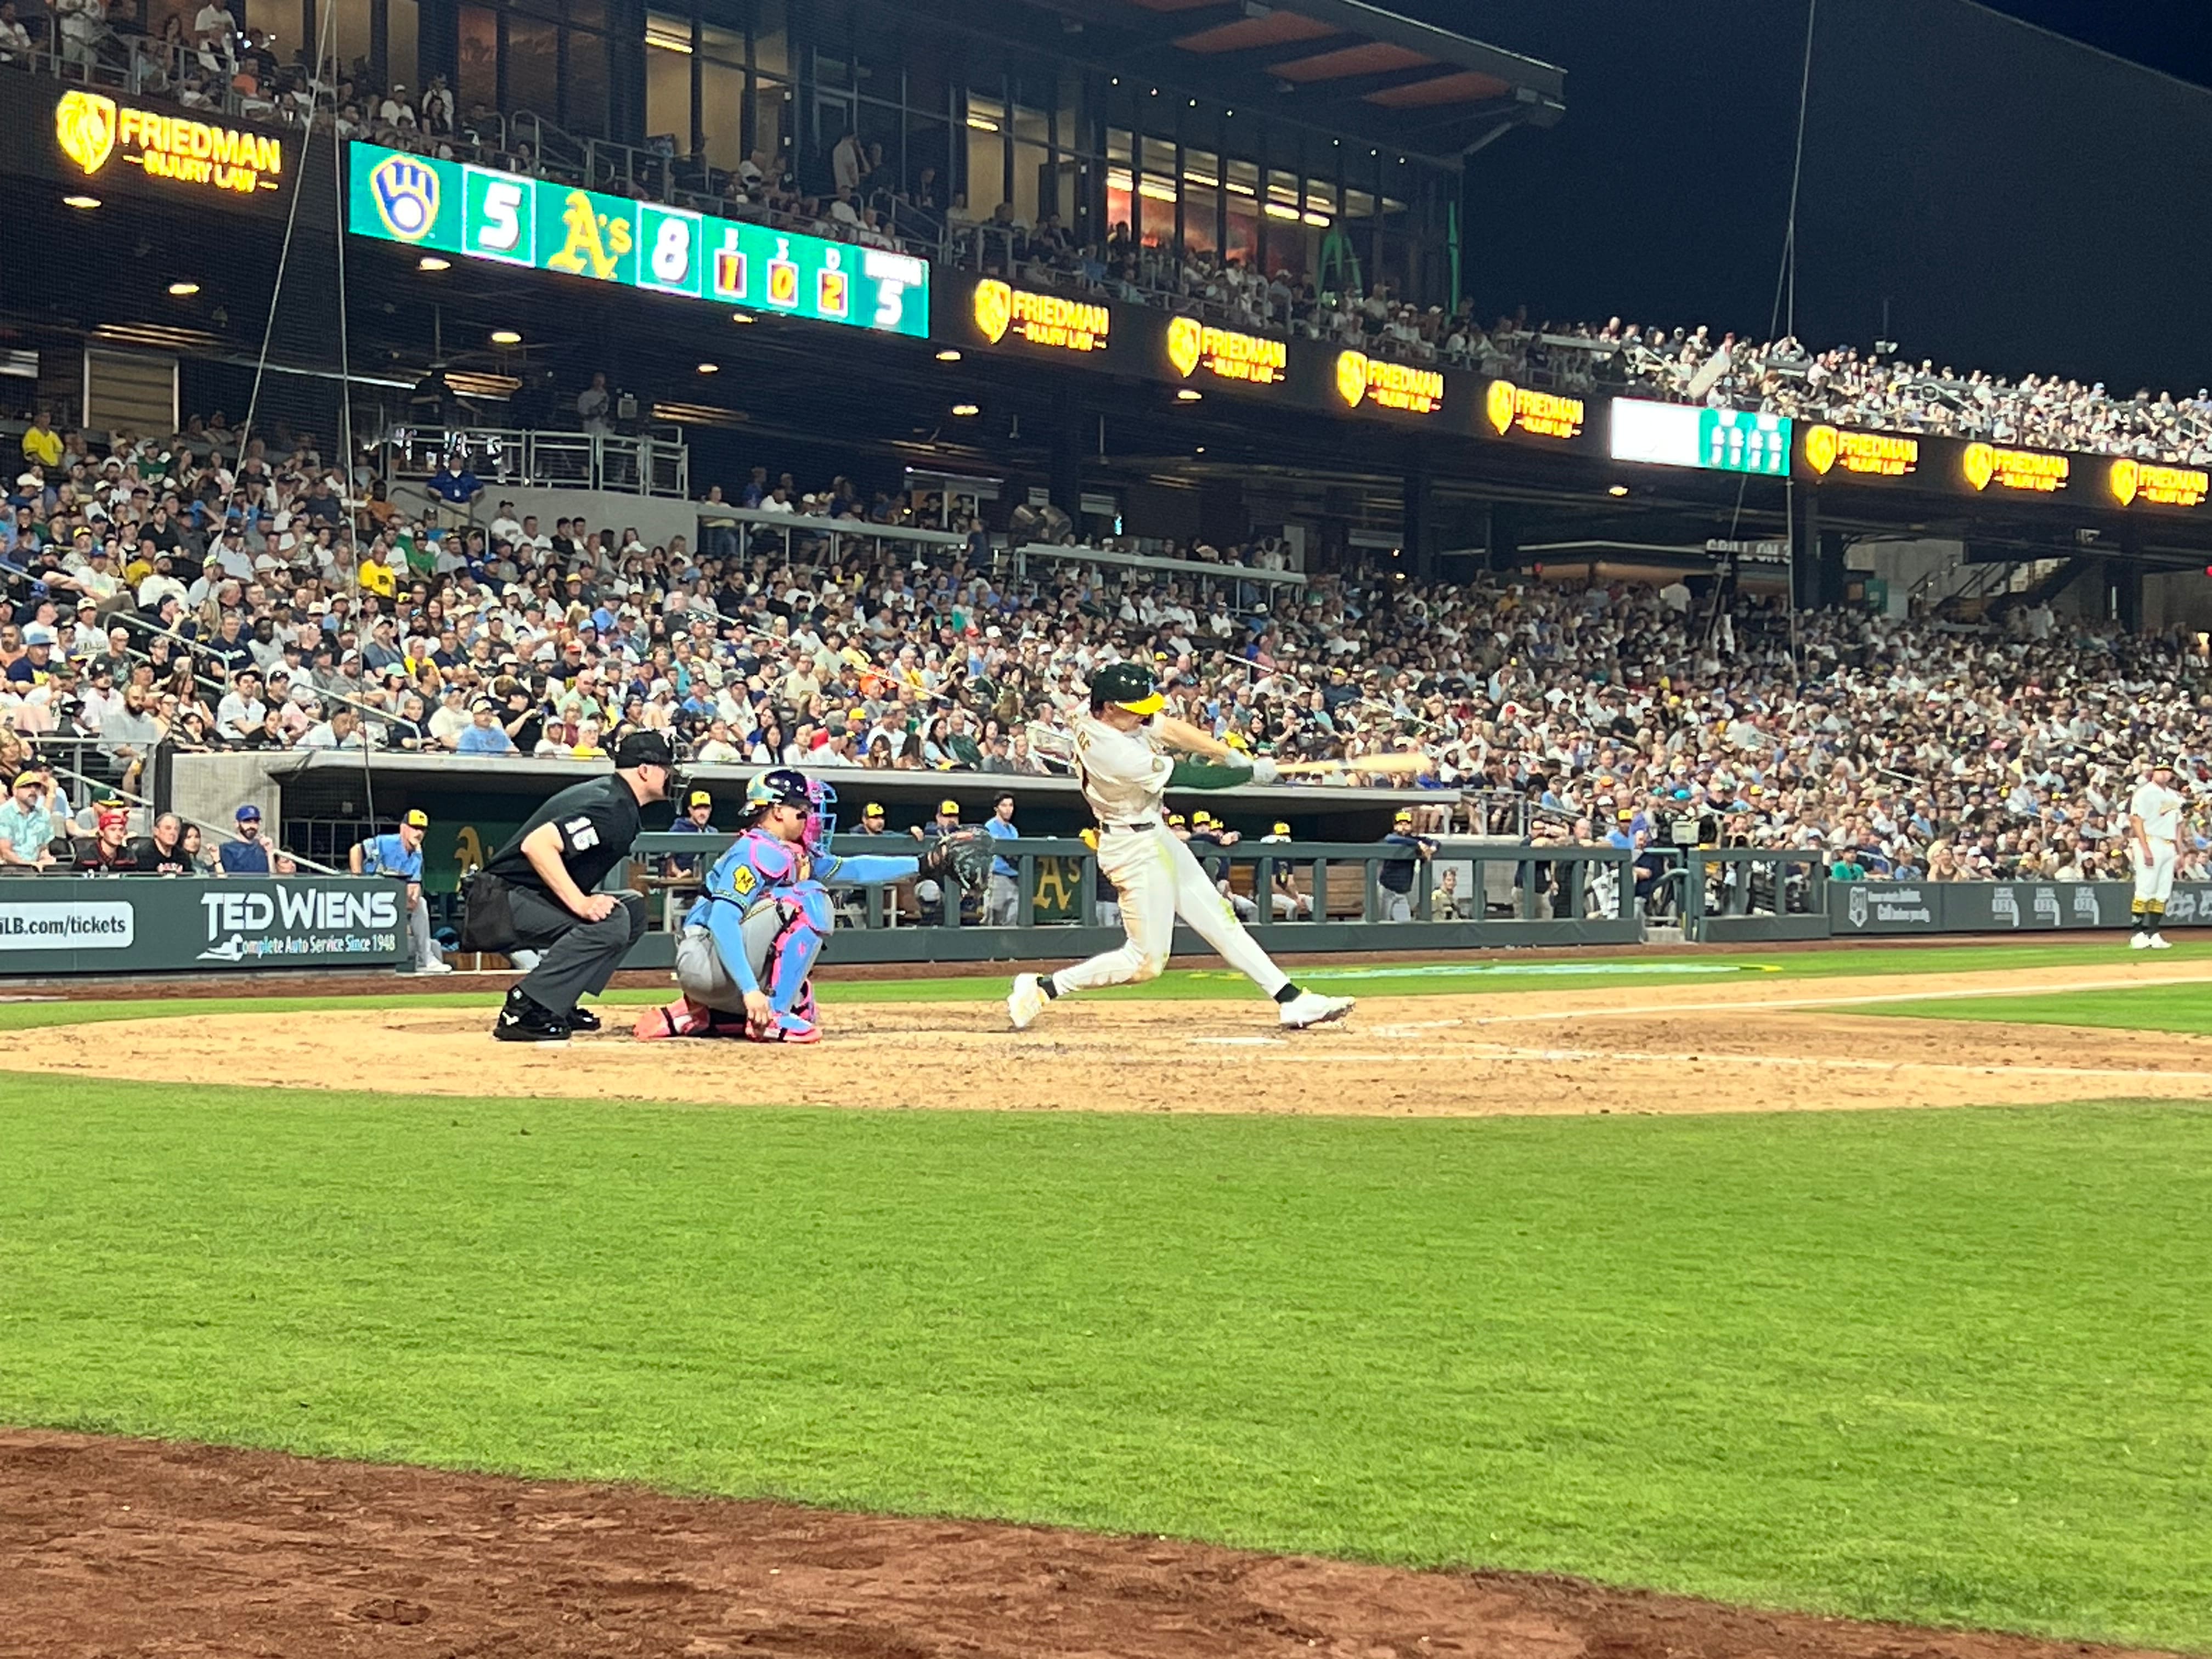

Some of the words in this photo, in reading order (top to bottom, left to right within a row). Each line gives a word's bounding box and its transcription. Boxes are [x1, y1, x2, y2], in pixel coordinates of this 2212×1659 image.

[120, 108, 281, 173] FRIEDMAN
[143, 149, 212, 184] INJURY
[213, 164, 257, 194] LAW
[478, 182, 522, 250] 5
[548, 190, 633, 279] A's
[652, 218, 690, 284] 8
[723, 255, 739, 291] 1
[772, 266, 794, 300] 0
[822, 275, 843, 310] 2
[874, 279, 904, 325] 5
[1012, 290, 1109, 335] FRIEDMAN
[1201, 326, 1286, 368] FRIEDMAN
[1367, 360, 1443, 399] FRIEDMAN
[565, 816, 600, 851] 15
[200, 892, 274, 942] TED
[276, 883, 398, 930] WIENS
[285, 935, 308, 953] Auto
[310, 934, 343, 953] Service
[346, 934, 371, 952] Since
[373, 933, 396, 952] 1948
